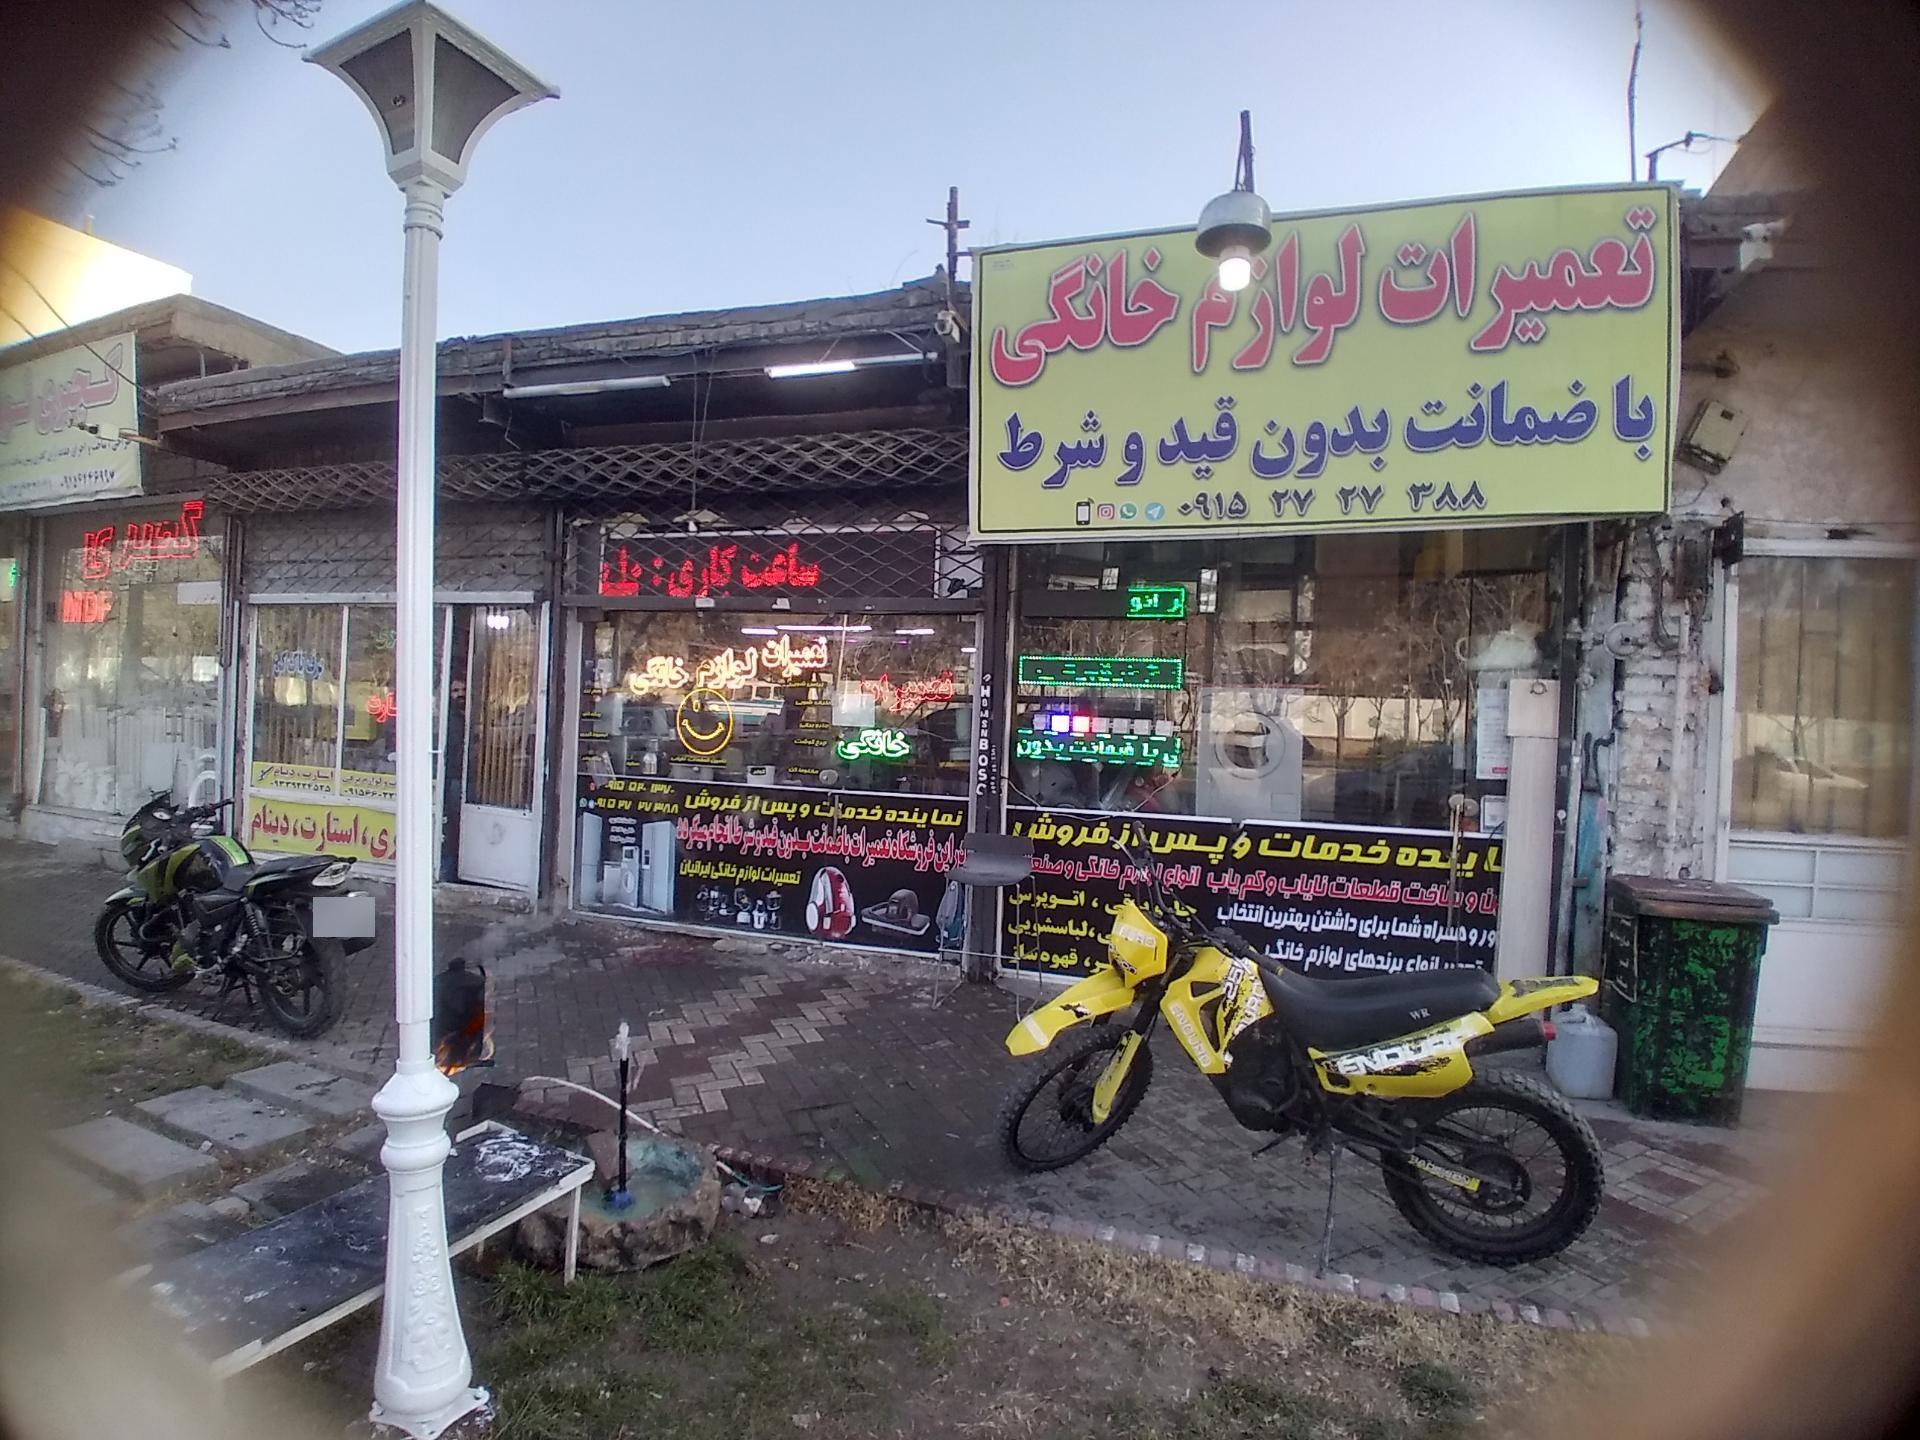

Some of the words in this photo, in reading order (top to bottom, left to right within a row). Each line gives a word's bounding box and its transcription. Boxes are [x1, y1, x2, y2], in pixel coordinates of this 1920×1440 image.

[1378, 206, 1659, 351] تعمیرات
[1190, 222, 1367, 374] لوازم
[990, 246, 1181, 387] خانگی
[1403, 377, 1599, 453] ضمانت
[1611, 374, 1658, 460] با
[996, 411, 1107, 490] شرط
[1156, 396, 1240, 480] قید
[1249, 404, 1391, 481] بدون
[1116, 437, 1144, 486] و
[1177, 488, 1249, 520] ۰۹۱۵
[1270, 488, 1313, 517] ۲۷
[1337, 483, 1385, 515] ۲۷
[1408, 480, 1486, 511] ۳۸۸
[741, 543, 820, 588] ساعت
[63, 590, 112, 623] MDF
[696, 646, 759, 690] لوازم
[761, 633, 829, 679] تعمیرات
[629, 655, 690, 696] خانگی
[837, 728, 913, 762] خانگی
[684, 788, 741, 814] فروش
[742, 794, 759, 815] از
[760, 799, 798, 822] پس
[799, 803, 812, 819] و
[814, 800, 883, 822] خدمات
[1013, 813, 1112, 846] فروش
[1150, 829, 1230, 864] پس
[1231, 834, 1254, 861] و
[1257, 831, 1392, 865] خدمات
[710, 862, 737, 880] خانگی
[735, 865, 761, 886] لوازم
[761, 867, 802, 886] تعمیرات
[1074, 855, 1120, 882] خانگی
[1162, 863, 1202, 894] انواع
[1278, 873, 1329, 901] نایاب
[1329, 876, 1402, 905] قطعات
[1215, 901, 1265, 926] انتخاب
[1263, 904, 1311, 933] بهترین
[1310, 907, 1358, 933] داشتن
[1357, 913, 1391, 941] برای
[1390, 913, 1423, 939] شما
[1303, 944, 1344, 973] لوازم
[1344, 948, 1404, 974] برندهای
[1408, 1006, 1431, 1022] WR
